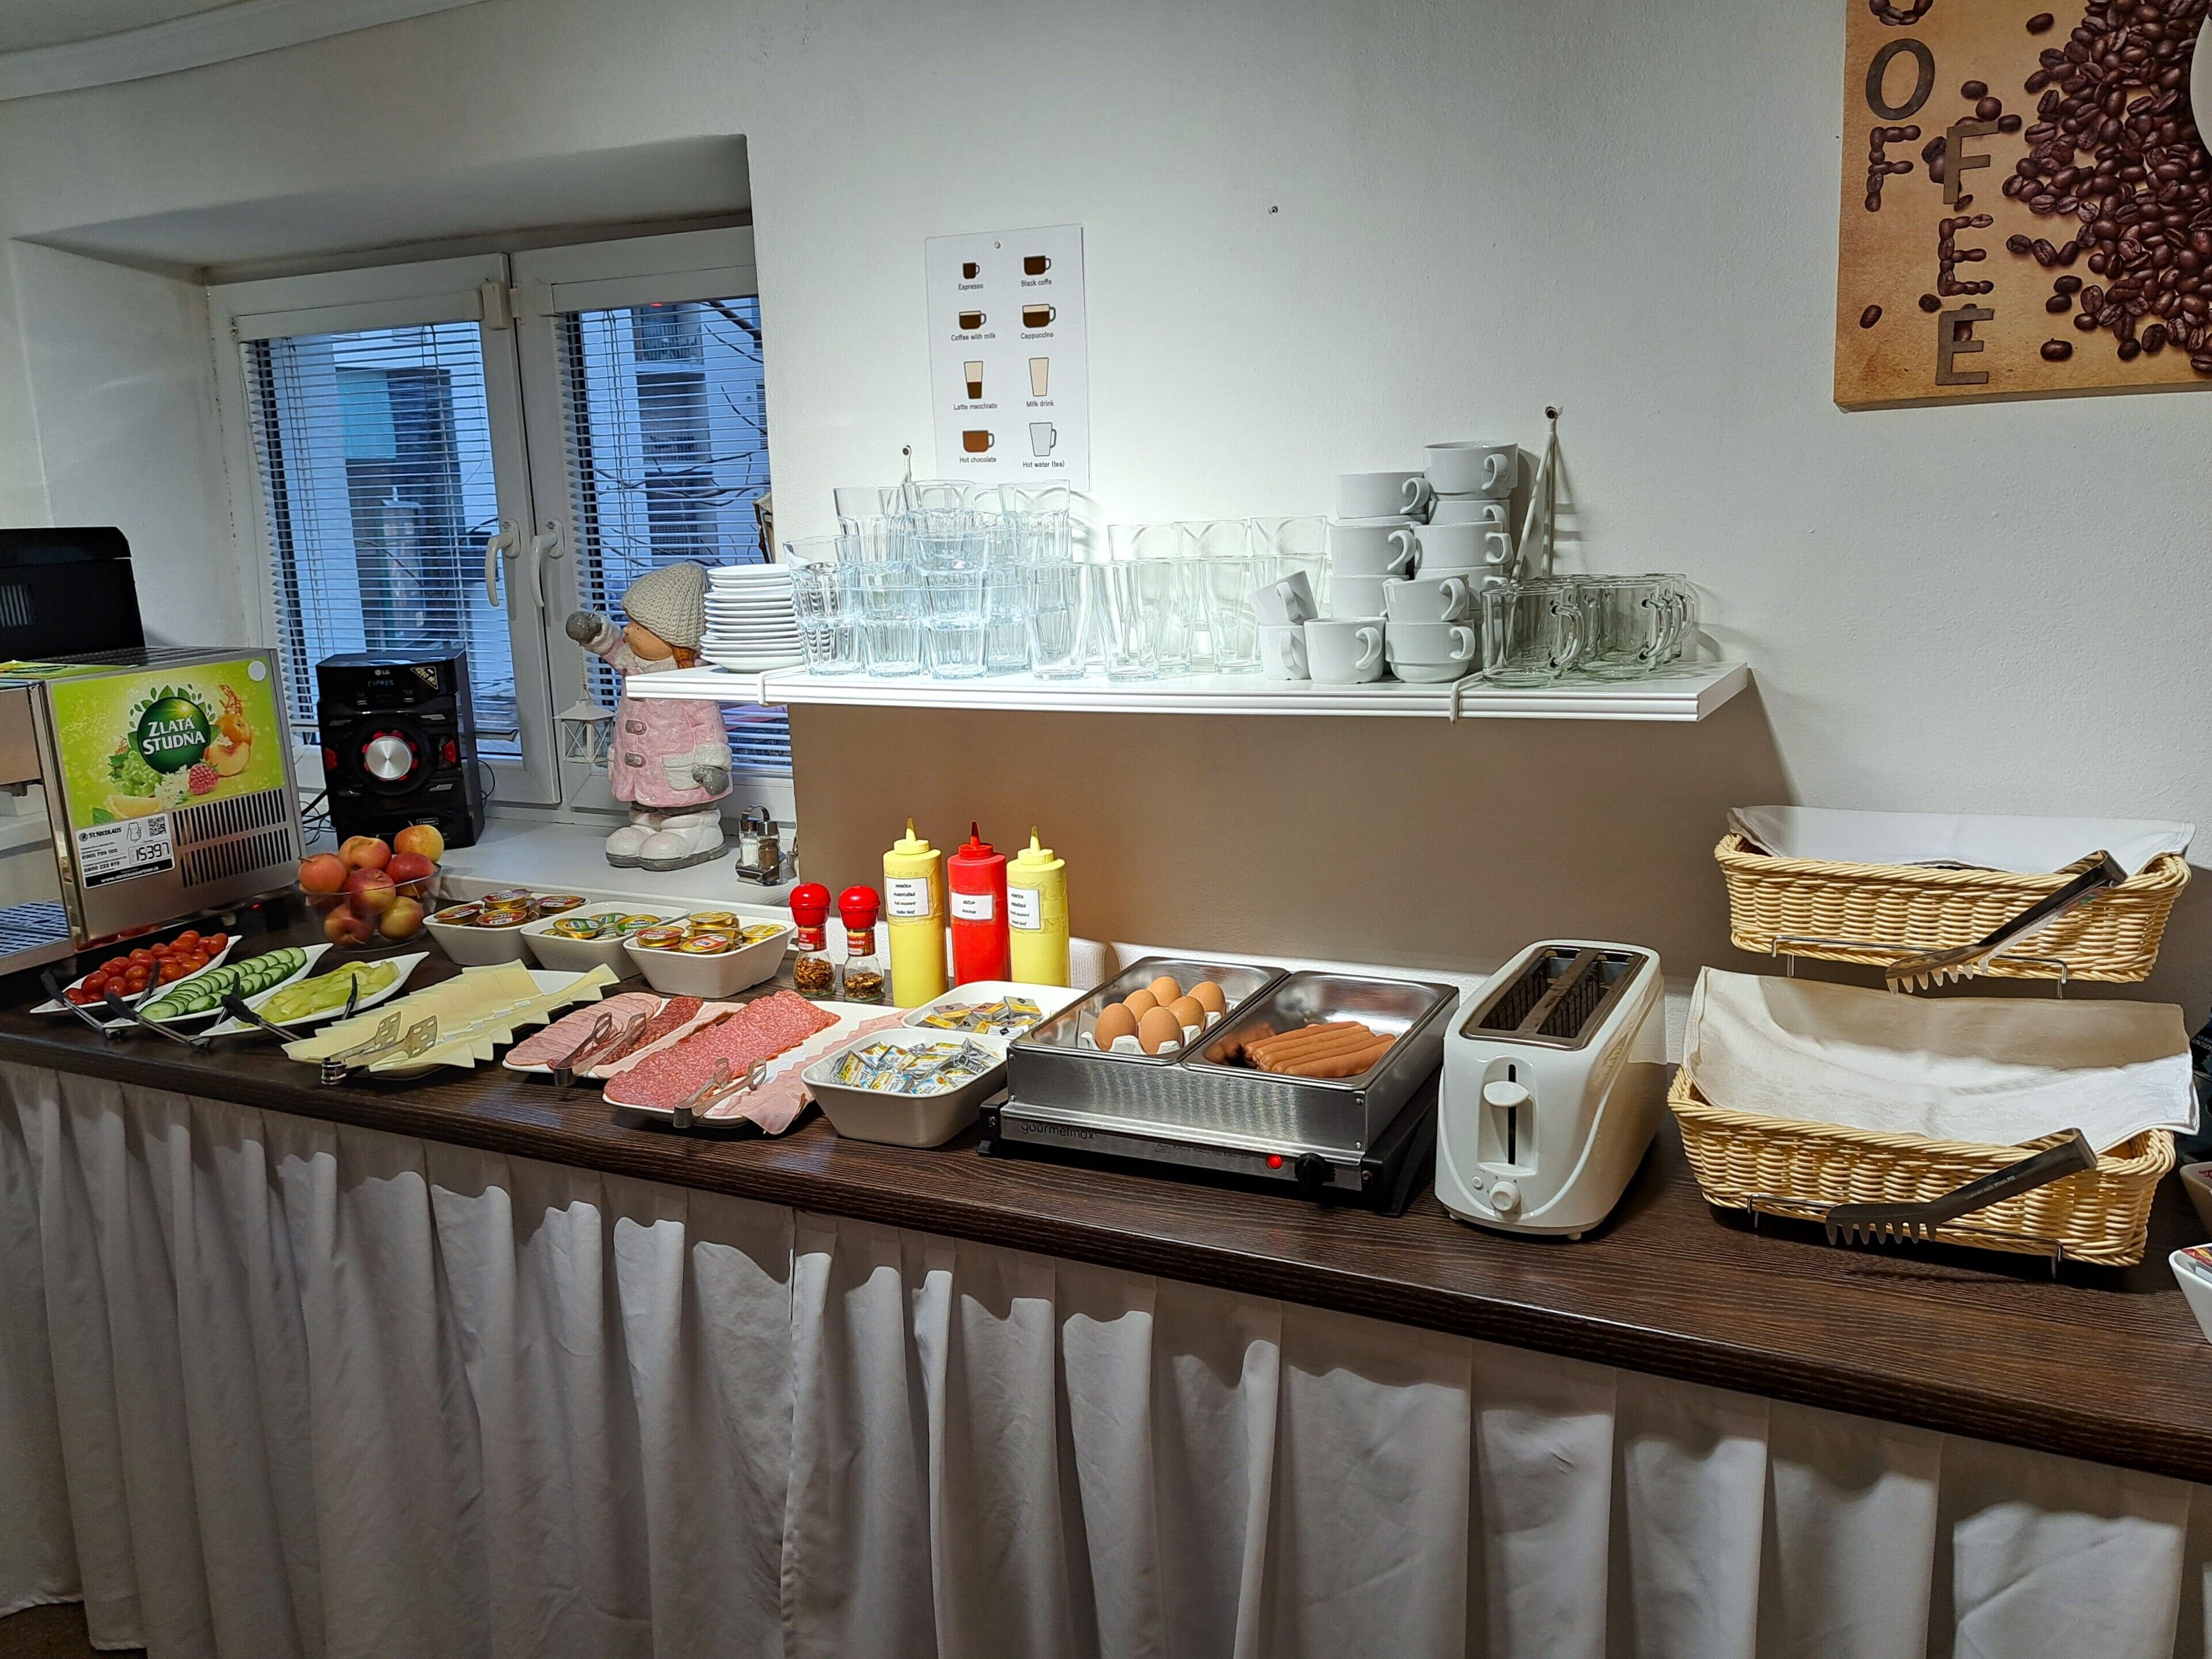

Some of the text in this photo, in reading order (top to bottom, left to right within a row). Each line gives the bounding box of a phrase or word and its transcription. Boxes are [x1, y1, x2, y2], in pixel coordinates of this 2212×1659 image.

[1020, 332, 1054, 340] Cappuccino
[148, 715, 195, 737] ZLATÁ
[143, 731, 206, 755] STUDŇA
[136, 842, 169, 861] 15397
[1021, 1123, 1094, 1139] gourmetmax
